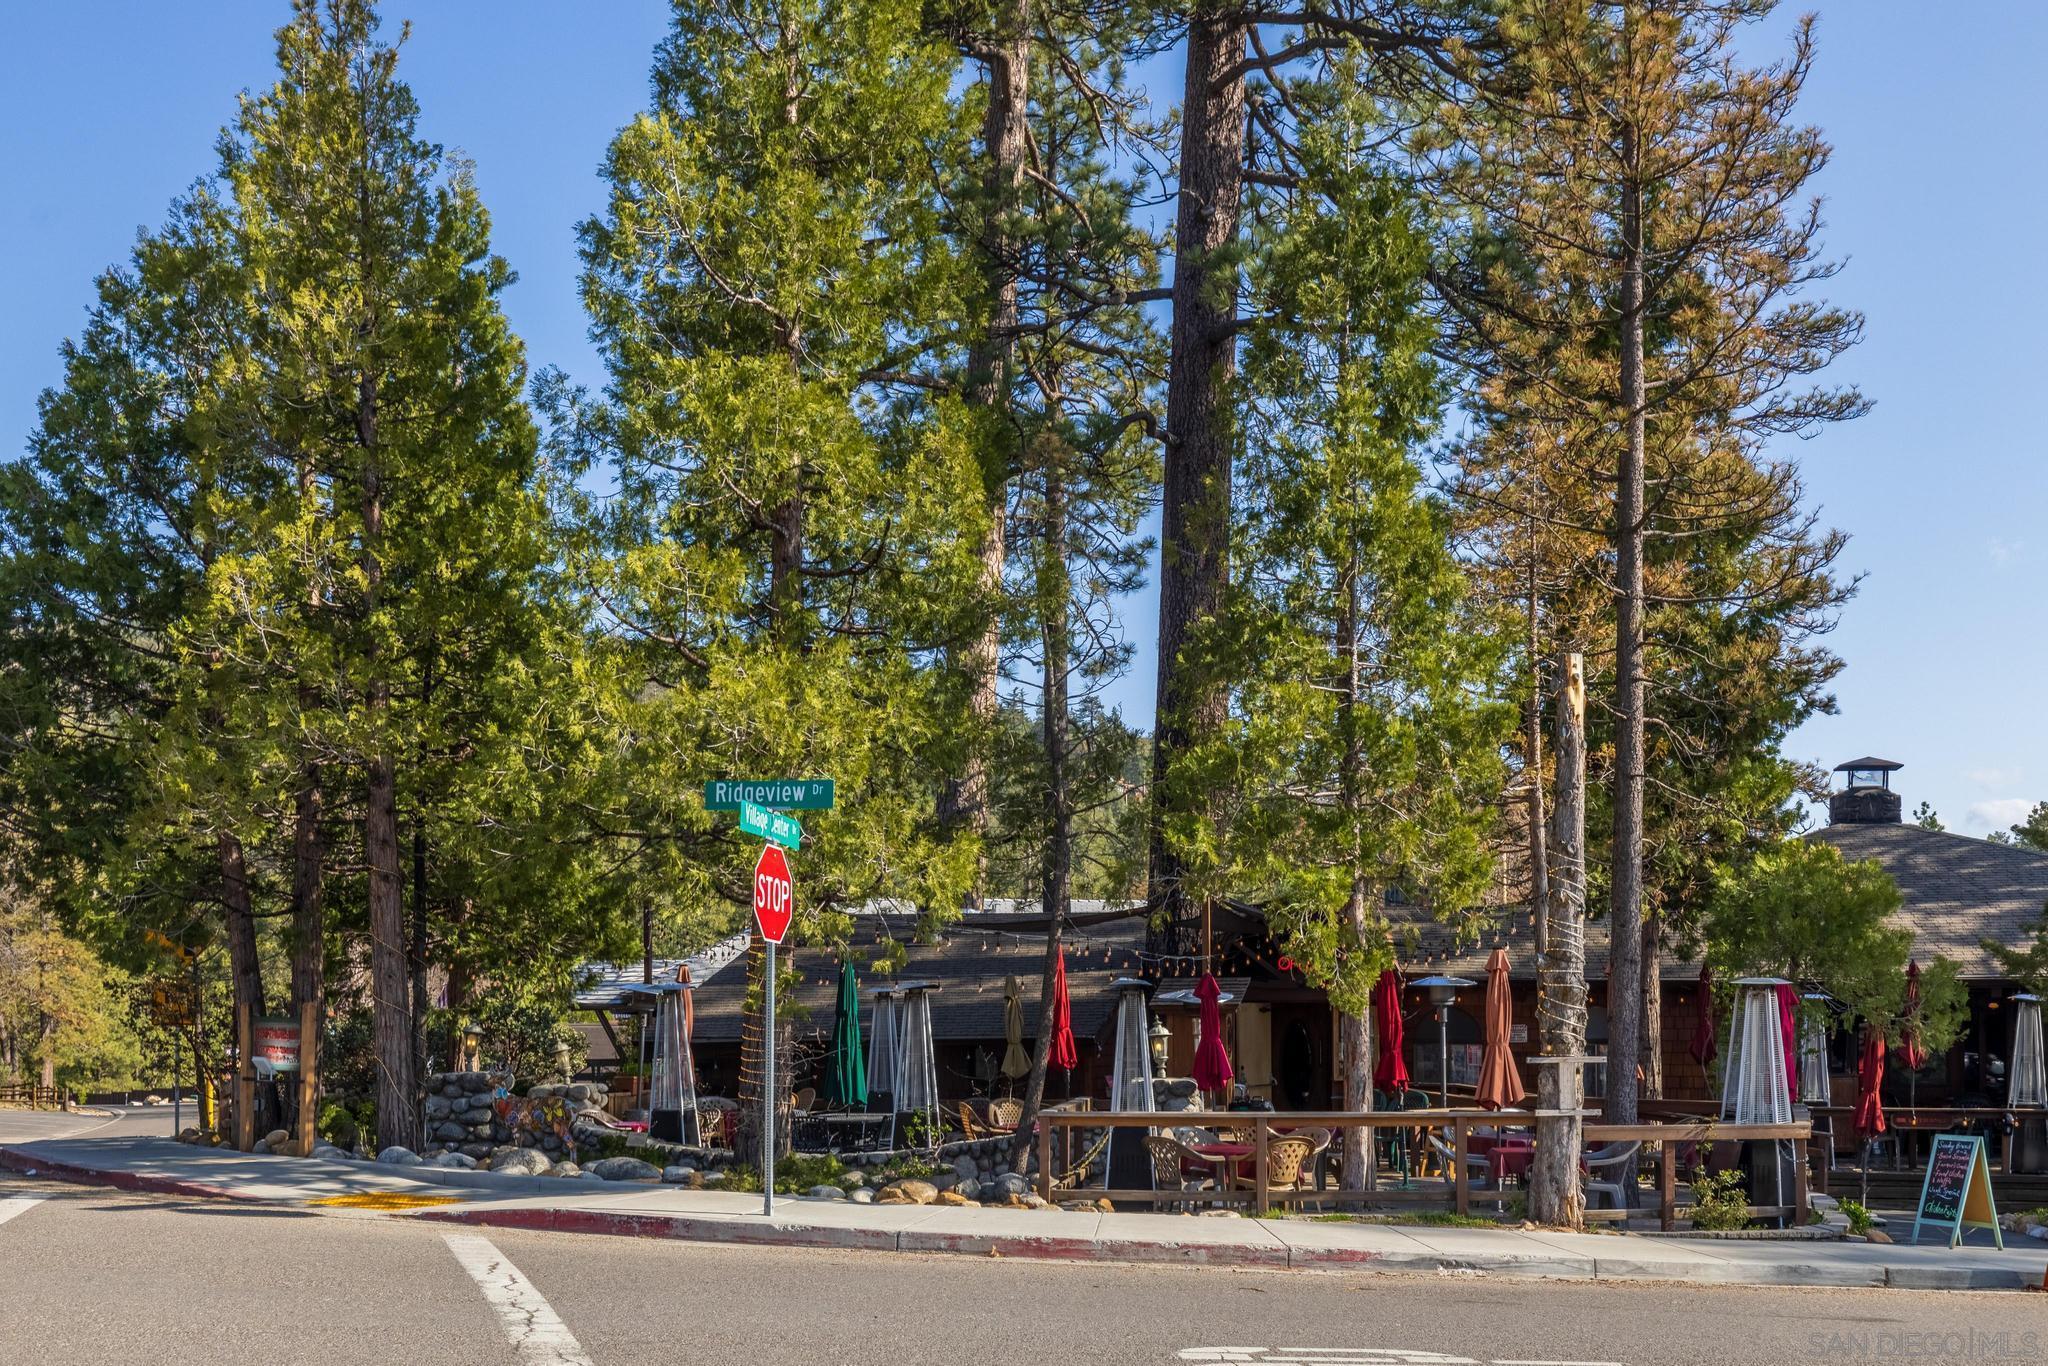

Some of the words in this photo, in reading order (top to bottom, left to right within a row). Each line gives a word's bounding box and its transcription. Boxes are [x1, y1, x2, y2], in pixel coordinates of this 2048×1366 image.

[716, 782, 805, 803] Ridgeview
[812, 784, 824, 795] Dr
[745, 803, 768, 835] Village
[757, 873, 790, 913] STOP
